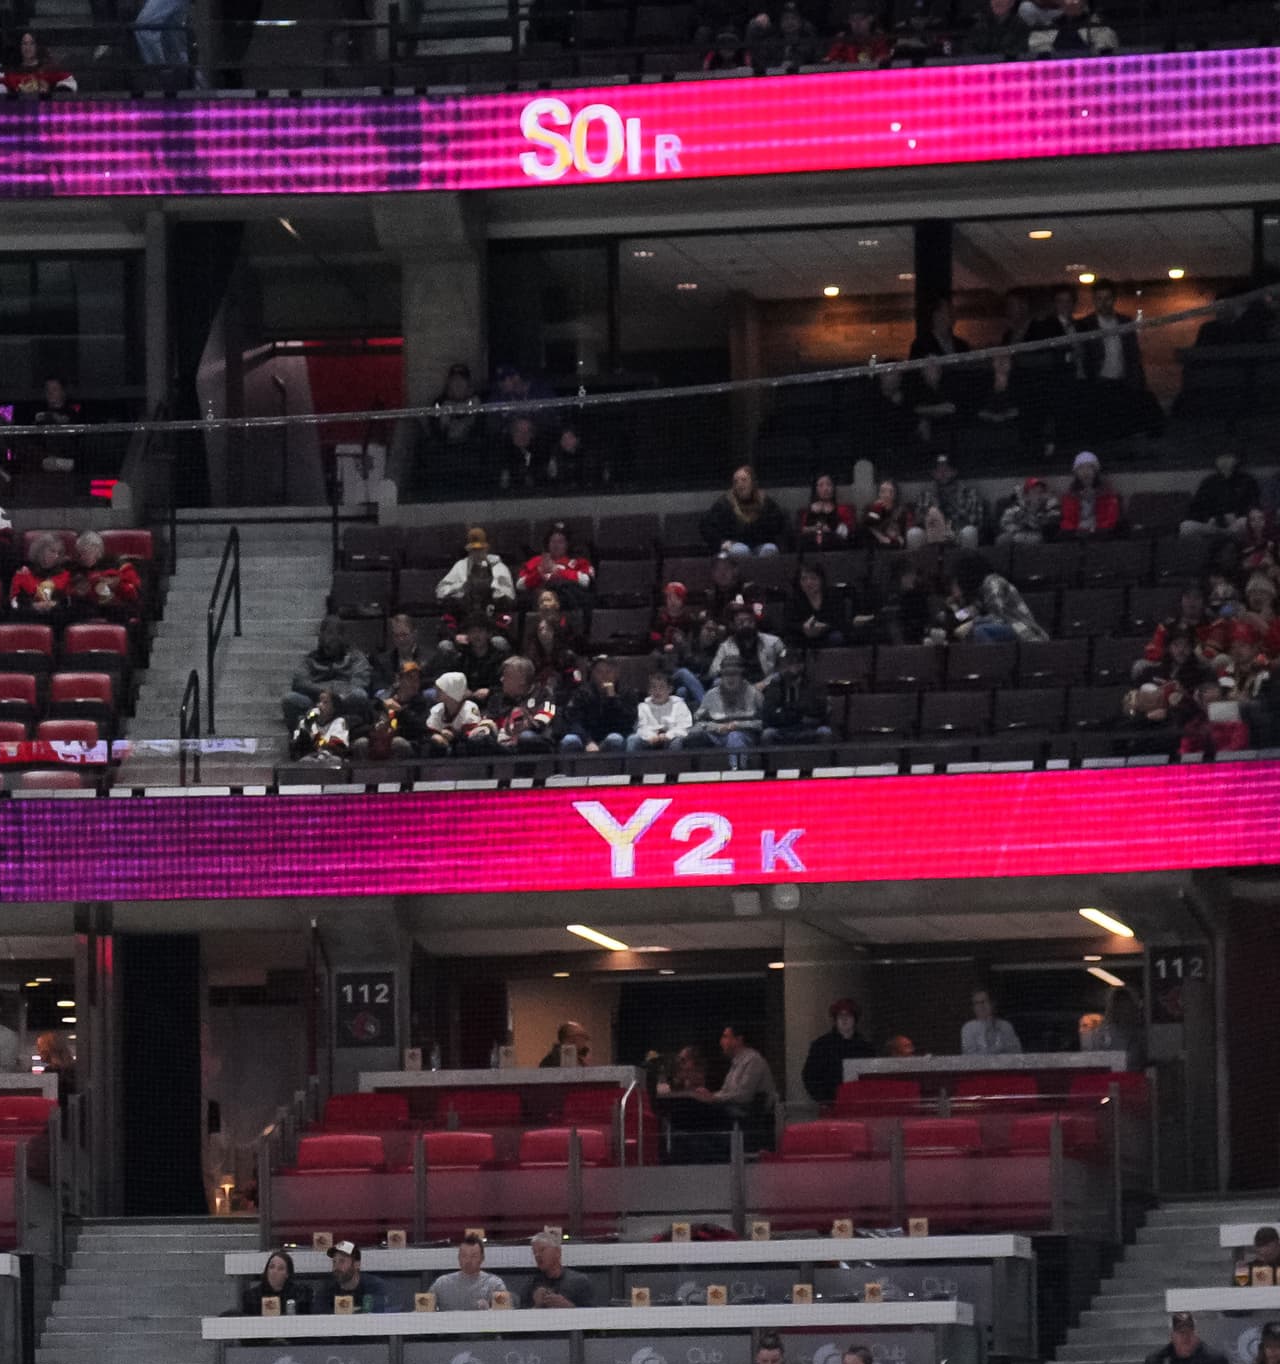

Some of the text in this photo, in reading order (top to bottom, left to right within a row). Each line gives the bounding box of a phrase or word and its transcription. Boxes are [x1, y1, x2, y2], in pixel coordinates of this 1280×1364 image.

[571, 797, 807, 879] Y2K
[1154, 957, 1203, 979] 112
[342, 983, 390, 1004] 112
